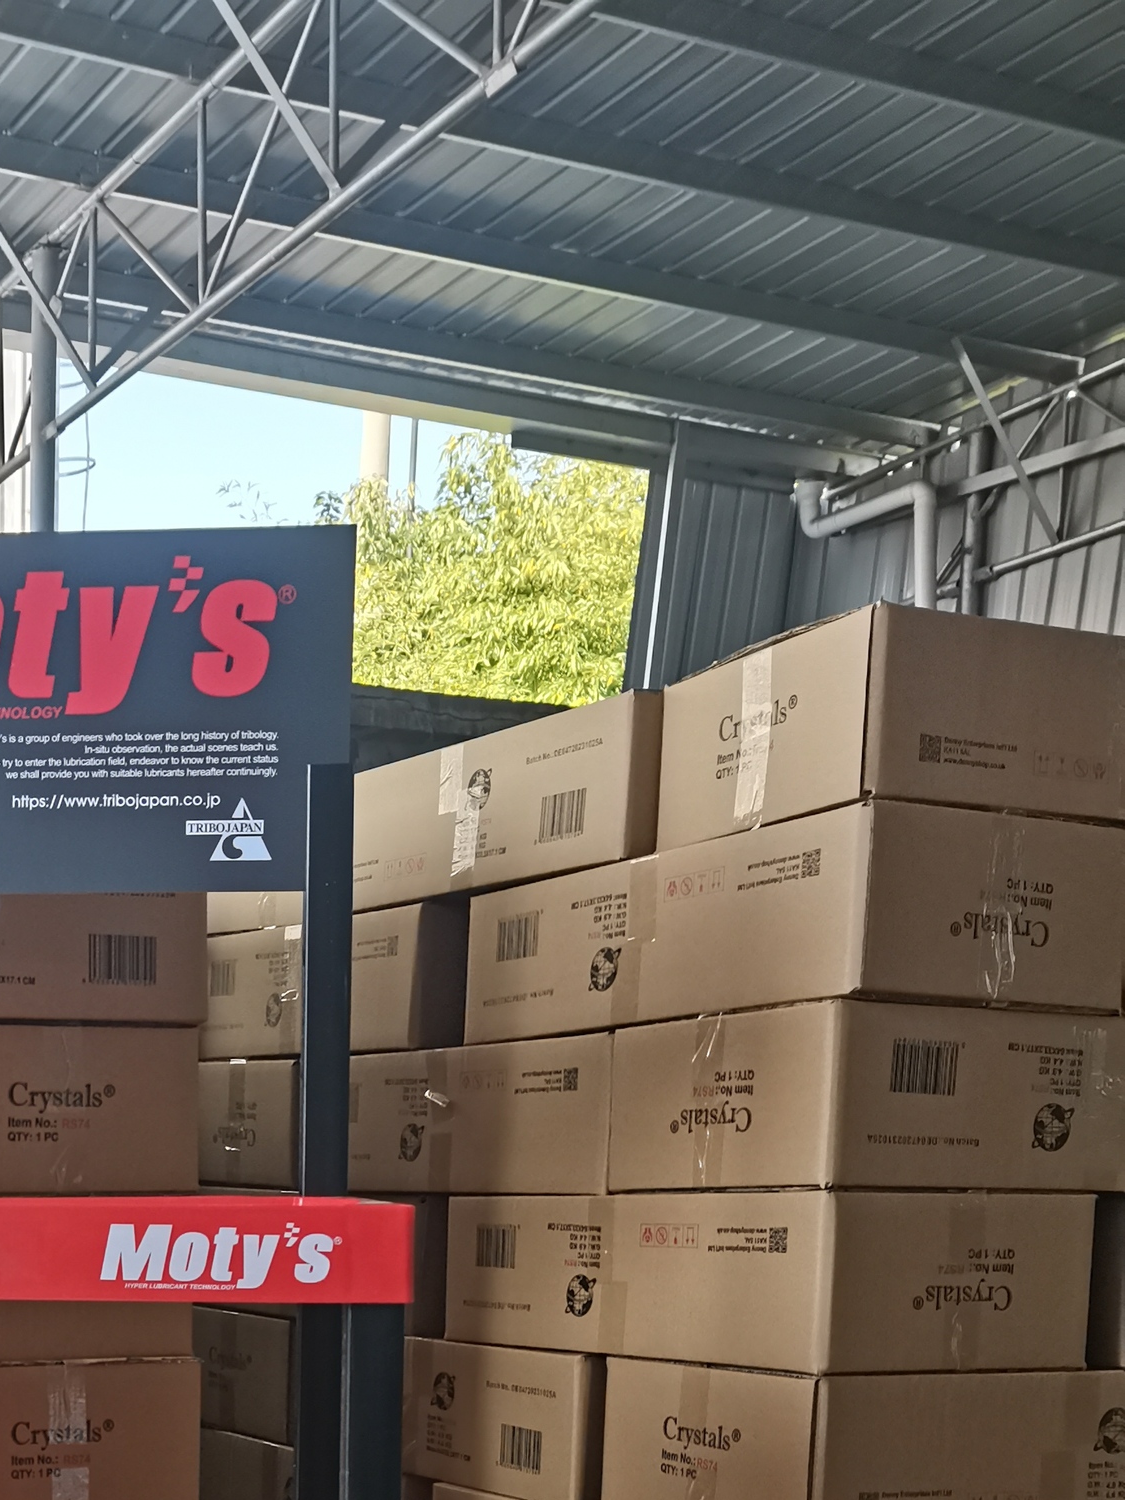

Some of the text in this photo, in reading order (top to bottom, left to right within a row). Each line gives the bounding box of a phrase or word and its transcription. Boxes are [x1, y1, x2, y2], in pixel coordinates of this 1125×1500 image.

[8, 733, 16, 743] is
[17, 735, 24, 743] a
[24, 734, 50, 745] group
[50, 732, 61, 742] of
[61, 732, 103, 744] engineers
[104, 732, 123, 741] who
[124, 731, 143, 741] took
[143, 733, 164, 741] over
[165, 731, 179, 740] the
[180, 730, 199, 742] long
[200, 730, 229, 741] history
[230, 729, 240, 739] of
[240, 729, 279, 741] tribology.
[84, 741, 278, 753] In-situ observation, the actual scenes teach us.
[1, 758, 13, 769] try
[14, 758, 23, 767] to
[24, 757, 47, 767] enter
[47, 757, 62, 766] the
[62, 756, 106, 766] lubrication
[107, 755, 127, 766] field,
[129, 755, 169, 765] endeavor
[170, 755, 180, 764] to
[180, 755, 204, 764] know
[205, 754, 219, 764] the
[220, 754, 251, 764] current
[252, 754, 279, 763] status
[4, 766, 277, 780] we shall provide you with suitable lubricants hereafter continuingly.
[11, 792, 220, 810] https://www.tribojapan.co.jp
[188, 822, 262, 833] TRIBOJAPAN
[715, 1069, 754, 1082] QTY: 1 PC
[715, 1085, 732, 1097] No.:
[735, 1085, 753, 1096] Item
[661, 1448, 718, 1472] Item No.: RS74
[661, 1463, 697, 1479] QTY: 1 PC
